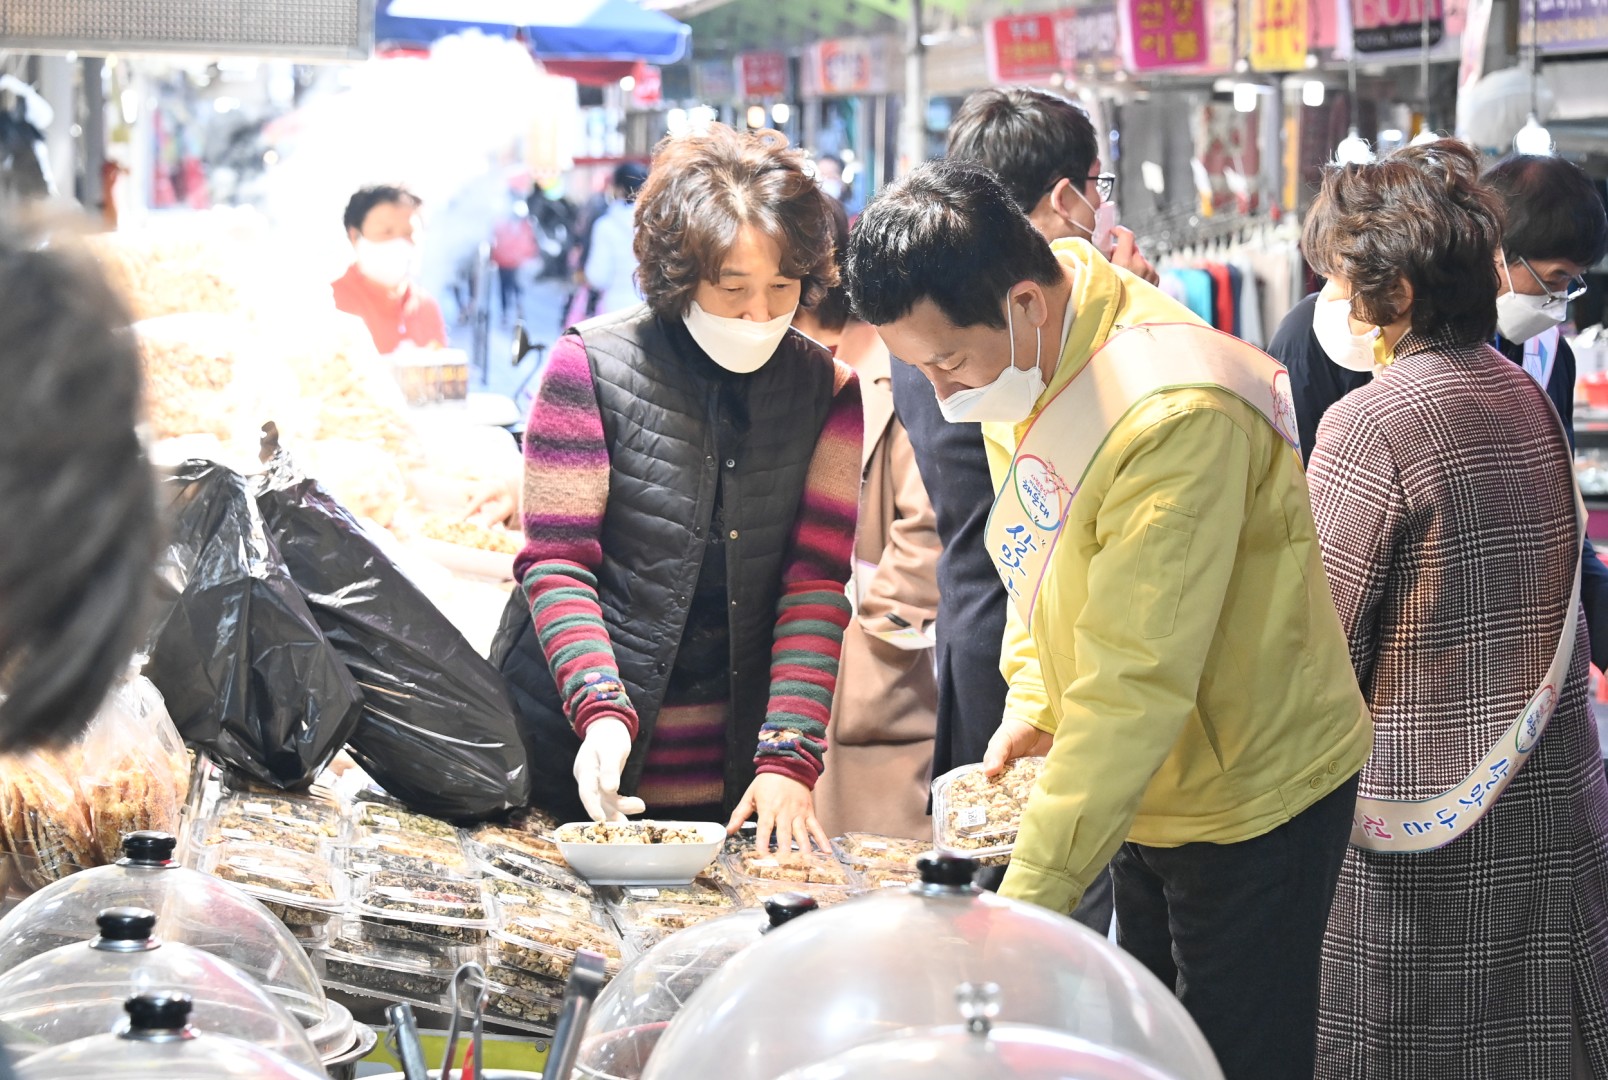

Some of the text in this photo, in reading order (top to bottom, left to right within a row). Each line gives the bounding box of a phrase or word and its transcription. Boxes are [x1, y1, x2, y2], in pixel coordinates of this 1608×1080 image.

[1022, 479, 1050, 519] 해운대
[998, 524, 1037, 603] 살맛나
[1353, 758, 1510, 840] 살맛나는 전
